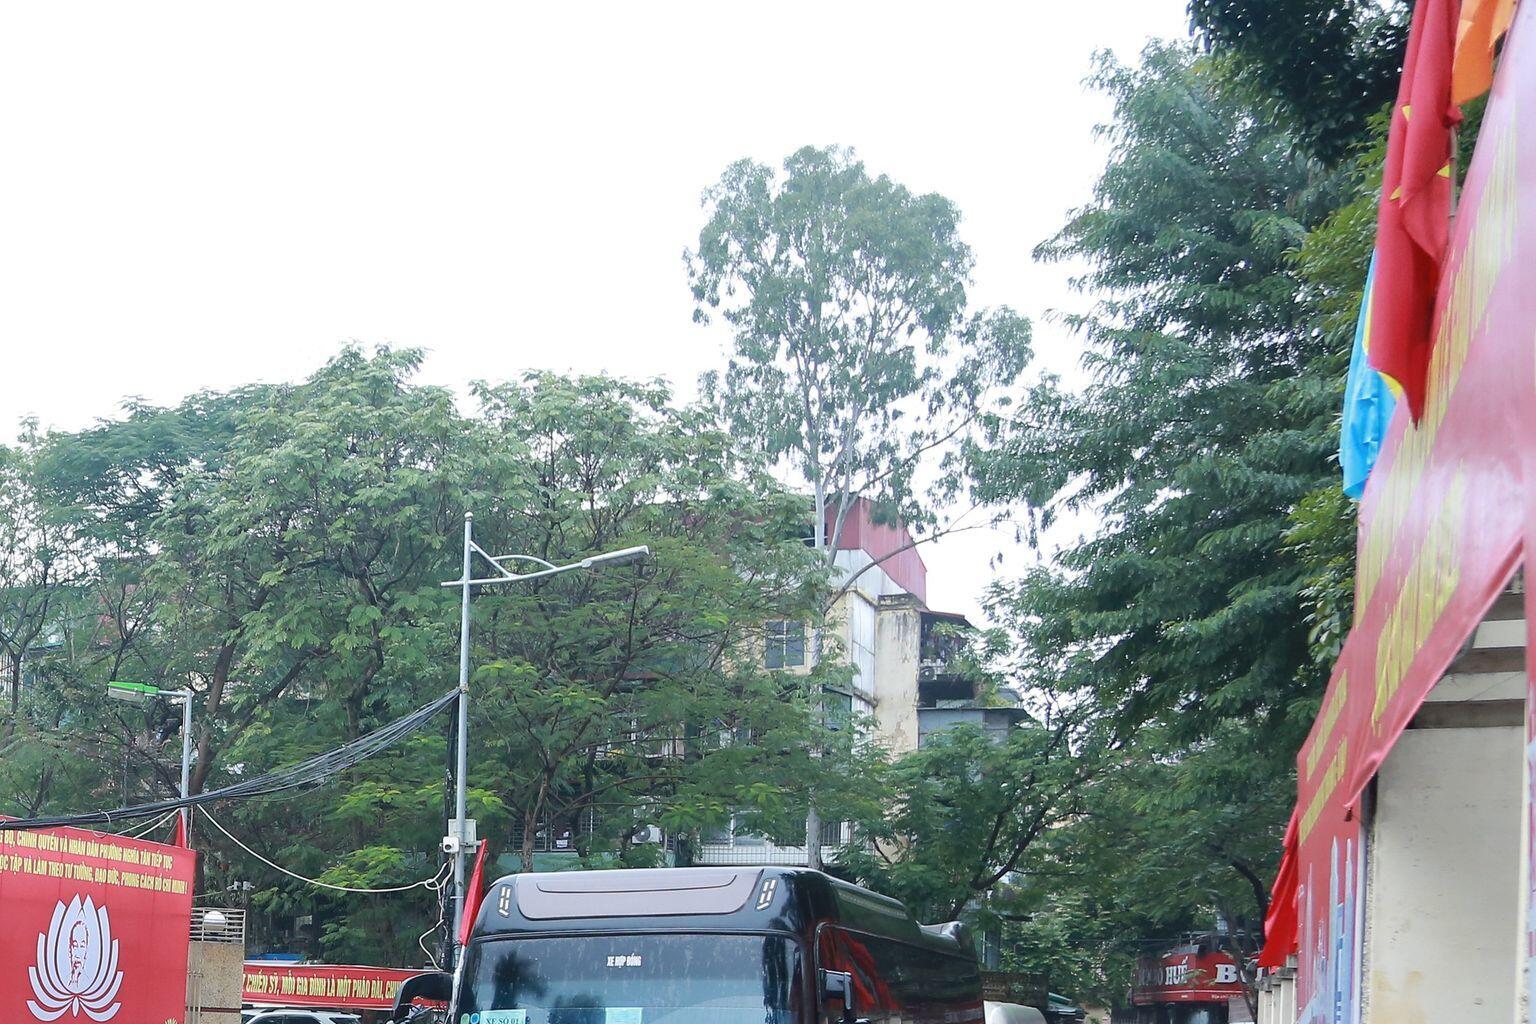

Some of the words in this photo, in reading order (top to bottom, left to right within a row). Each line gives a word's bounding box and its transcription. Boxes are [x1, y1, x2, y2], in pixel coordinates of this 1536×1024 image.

[16, 828, 38, 848] CHÍNH
[38, 831, 59, 852] QUYỀN
[60, 835, 68, 853] VÀ
[68, 838, 86, 855] NHÂN
[86, 840, 99, 857] DÂN
[99, 843, 123, 861] PHƯỜNG
[151, 849, 163, 868] TIẾP
[163, 854, 173, 872] TỤC
[9, 853, 23, 875] TẬP
[23, 855, 32, 874] VÀ
[32, 857, 47, 876] LÀM
[48, 861, 64, 878] THEO
[64, 863, 73, 878] TƯ
[94, 867, 107, 885] ĐẠO
[121, 872, 140, 888] PHONG
[140, 872, 154, 891] CÁCH
[154, 873, 163, 891] HỒ
[163, 876, 172, 893] CHÍ
[246, 969, 268, 993] CHIẾN
[281, 970, 296, 995] MỖI
[296, 976, 308, 995] GIA
[309, 973, 326, 996] ĐÌNH
[327, 974, 336, 997] LÀ
[336, 975, 352, 1001] MỘT
[352, 976, 370, 998] PHÁO
[1165, 956, 1188, 985] HUẾ
